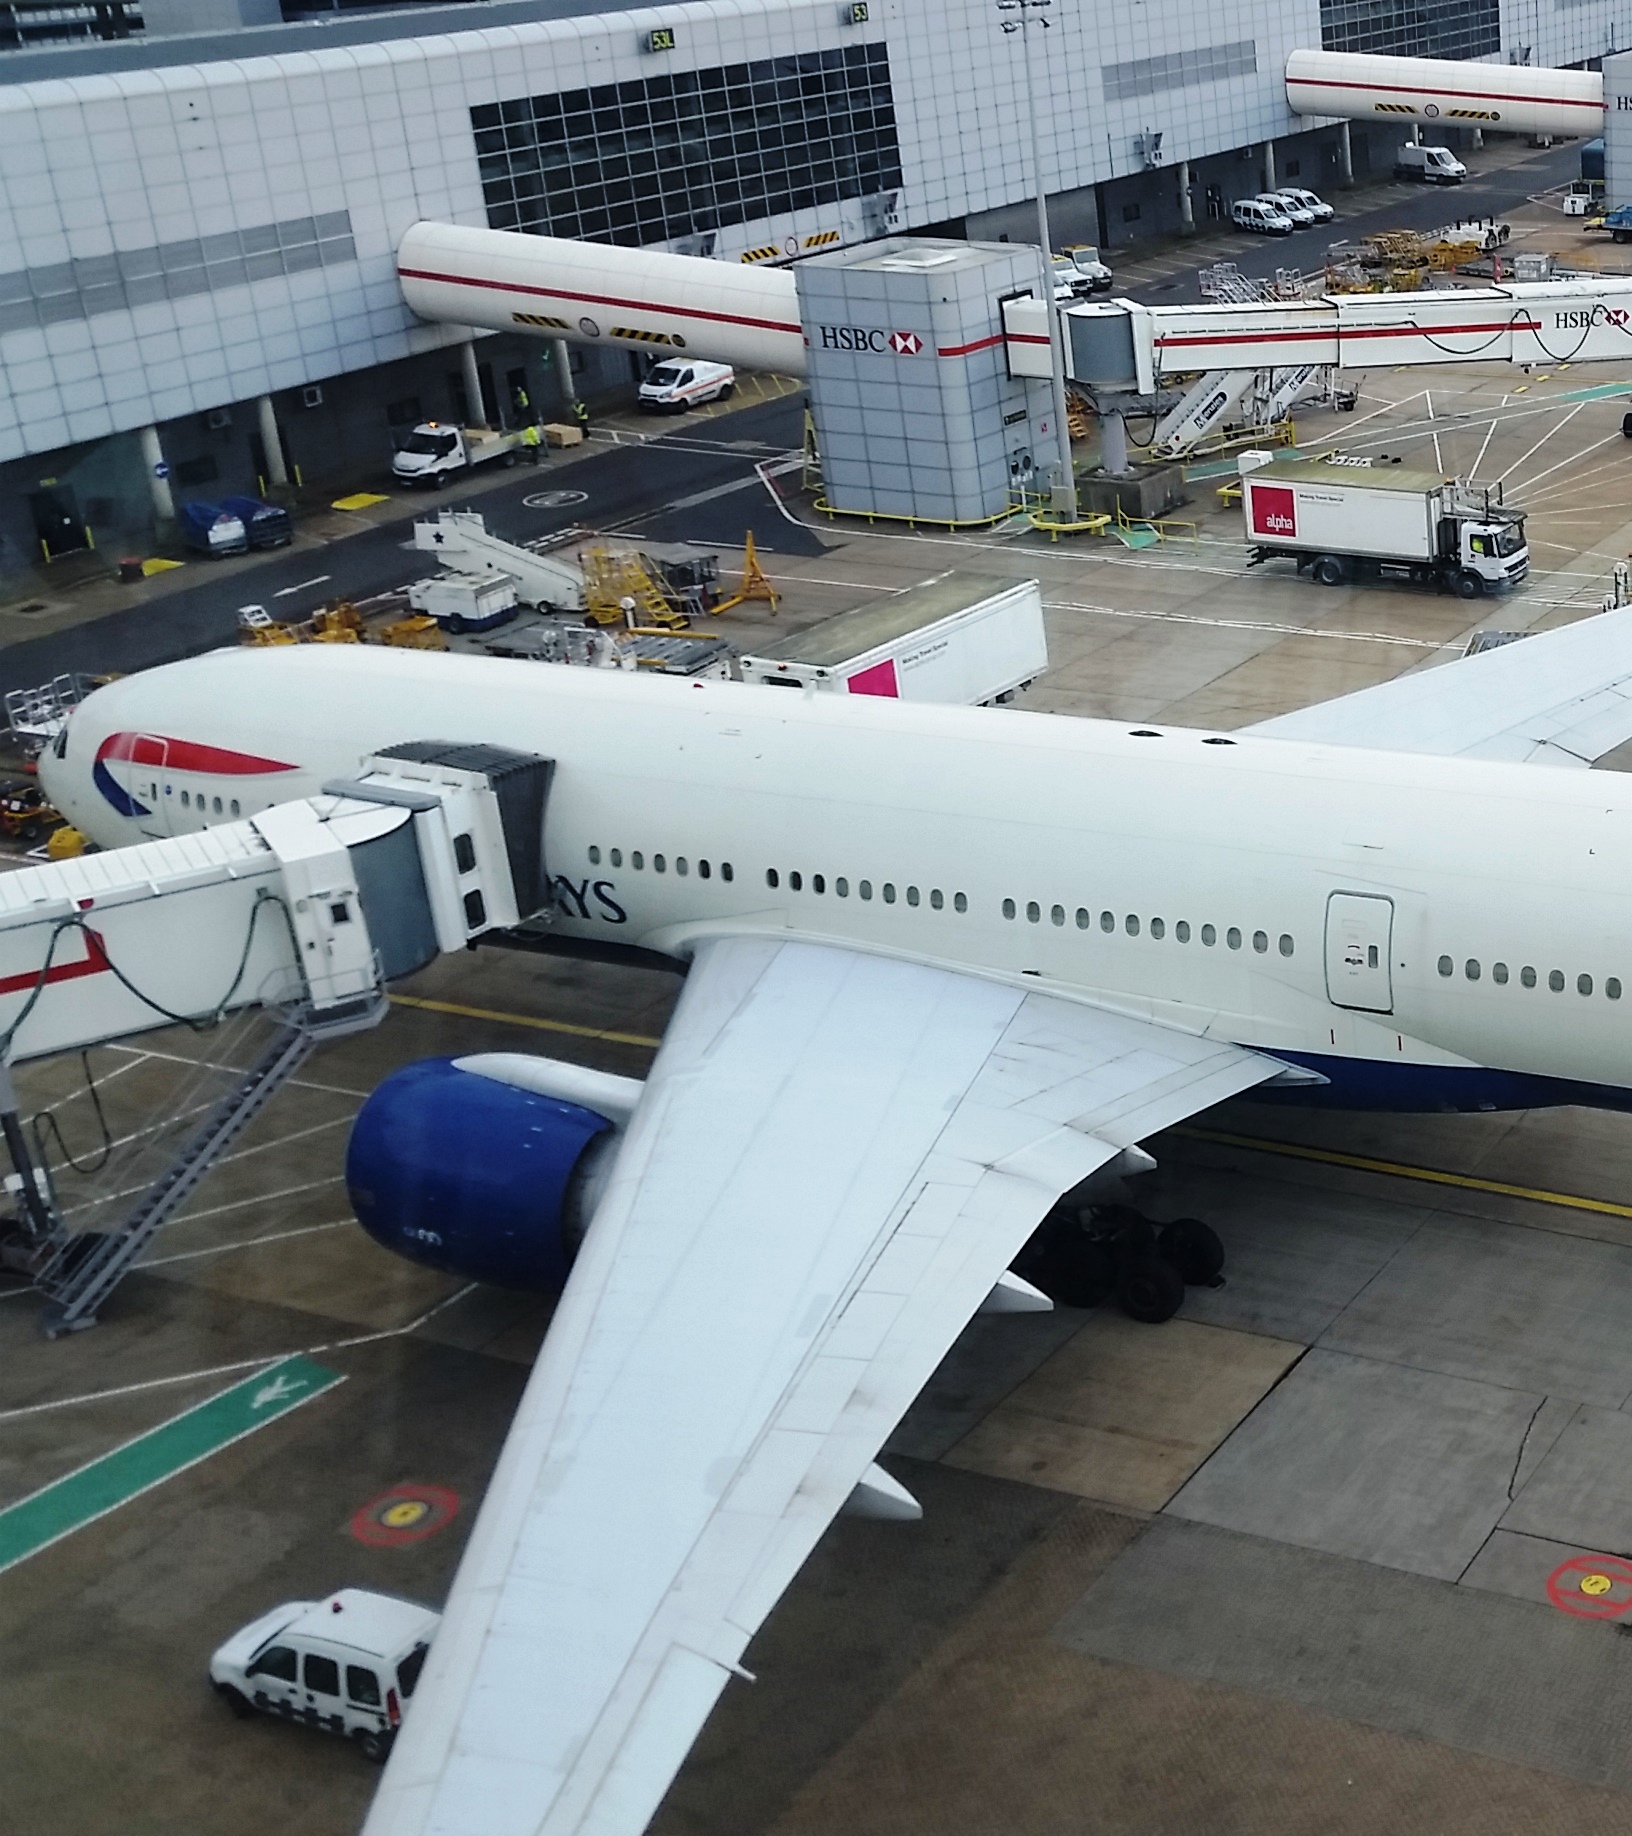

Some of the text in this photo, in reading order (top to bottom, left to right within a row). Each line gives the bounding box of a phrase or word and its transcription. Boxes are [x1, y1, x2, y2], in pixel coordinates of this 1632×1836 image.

[853, 4, 868, 21] 53
[652, 31, 675, 49] 53L
[1555, 310, 1603, 329] HSBC
[820, 325, 886, 353] HSBC
[1266, 513, 1294, 532] alpha
